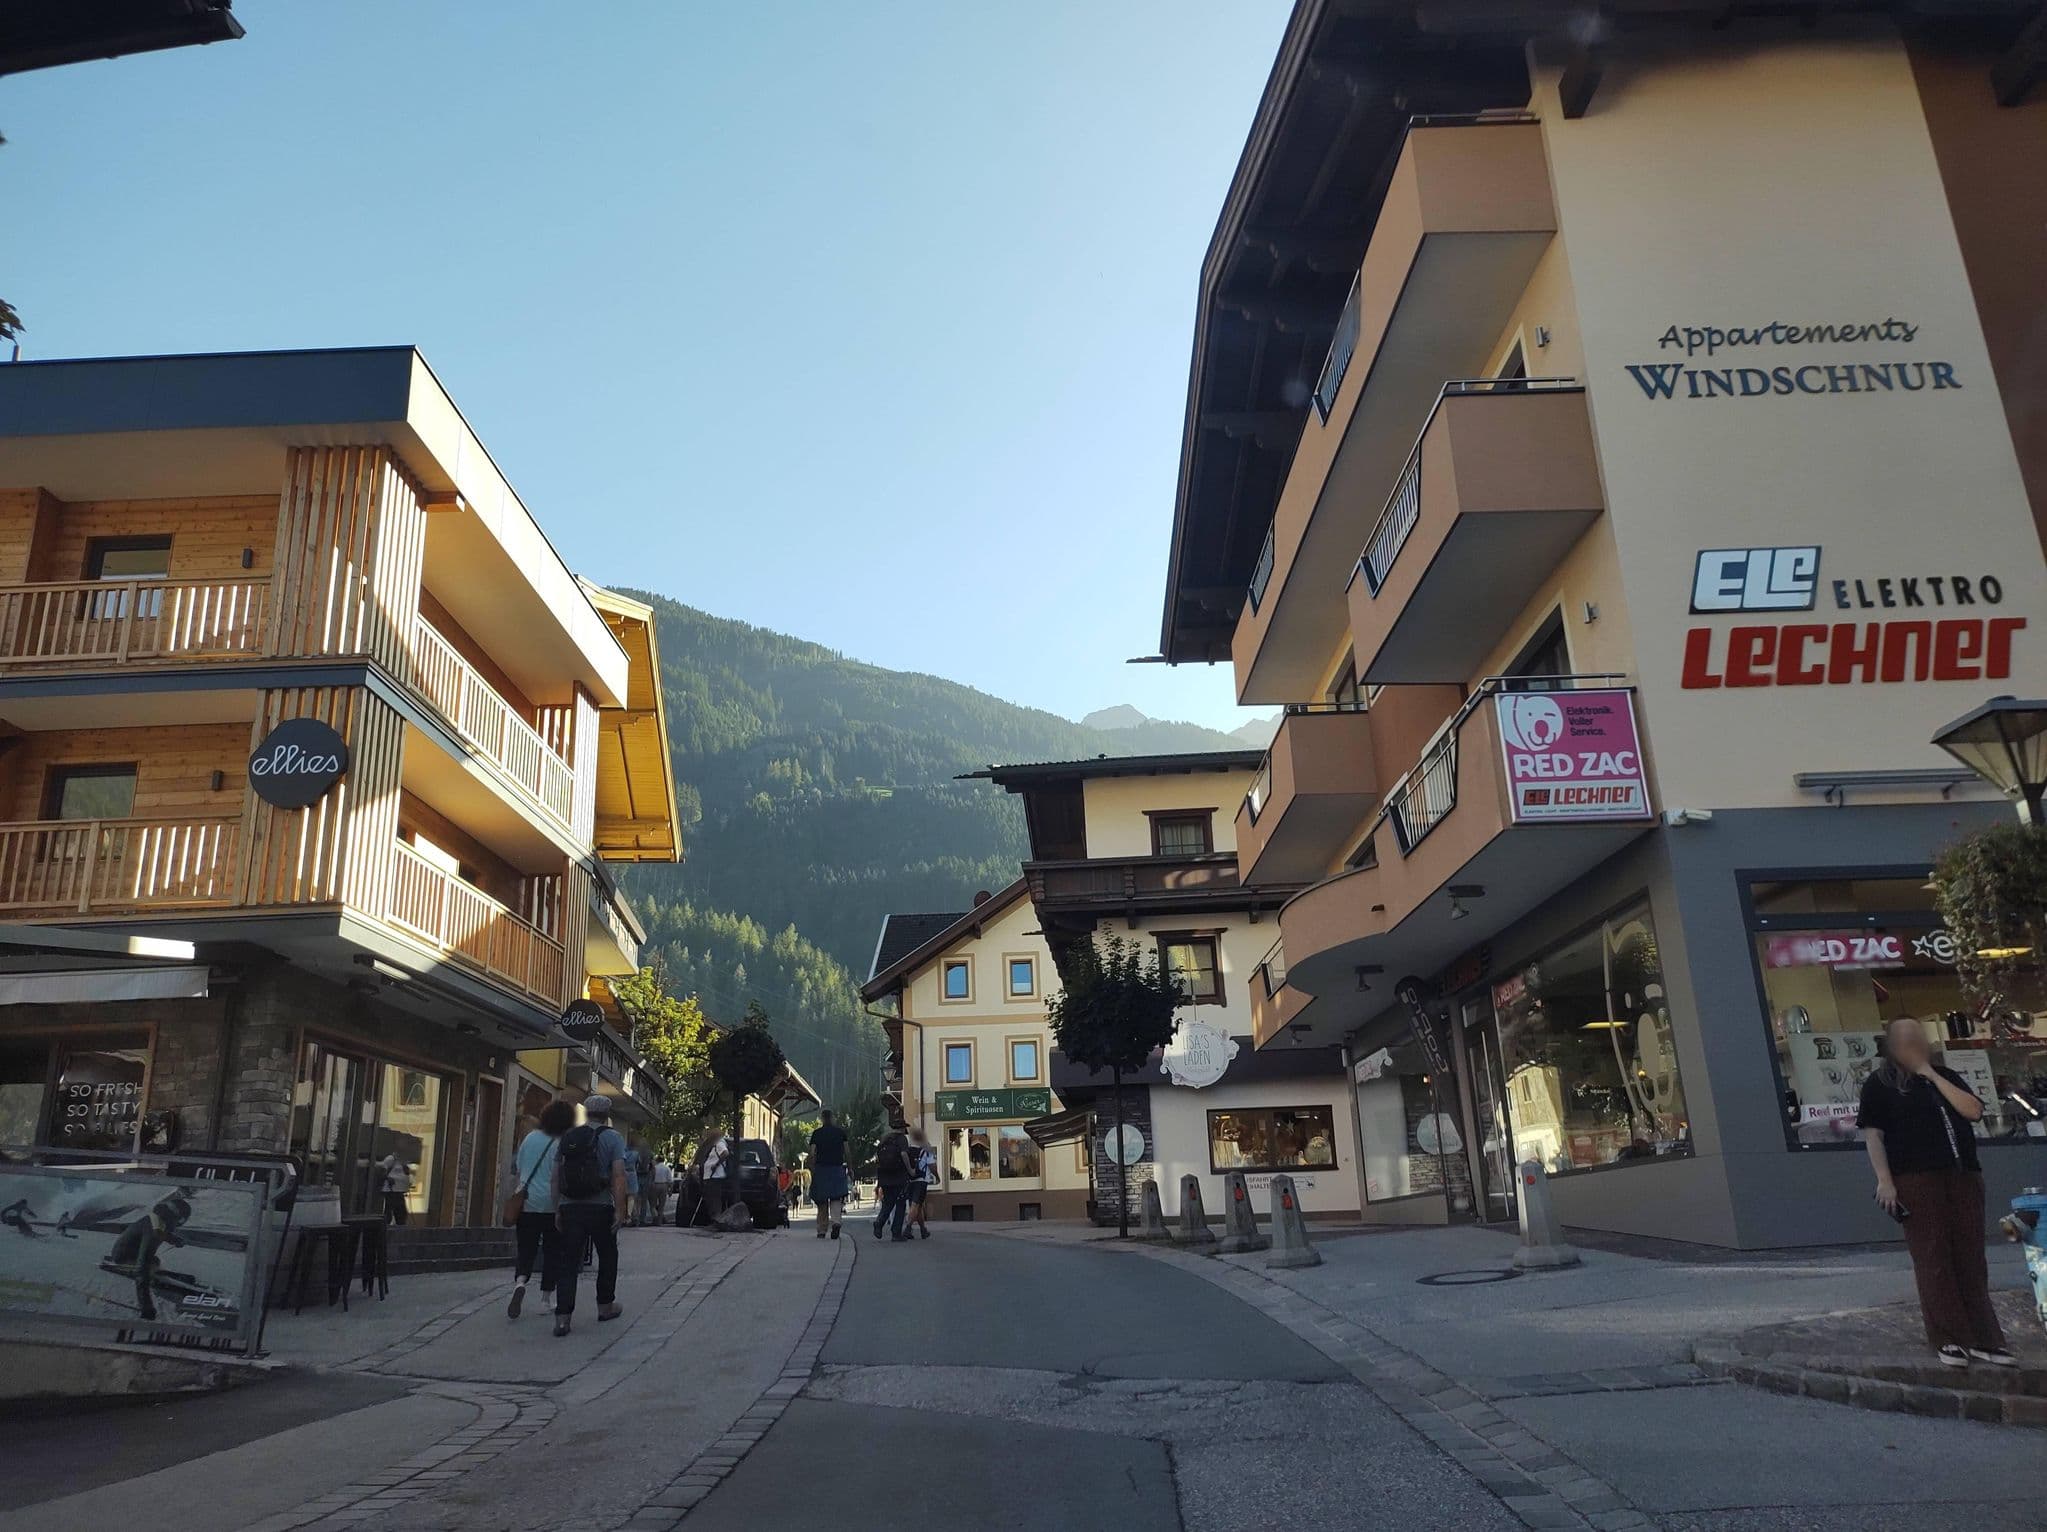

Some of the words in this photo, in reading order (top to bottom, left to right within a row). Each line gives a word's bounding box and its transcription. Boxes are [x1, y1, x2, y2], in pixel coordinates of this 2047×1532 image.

[1658, 317, 1919, 357] Appartements
[1625, 361, 1962, 400] WINDSCHNUR
[1832, 574, 2004, 609] ELEKTRO
[252, 745, 339, 775] ellies
[1512, 753, 1575, 778] RED
[1578, 751, 1638, 776] ZAC
[1849, 936, 1901, 959] ZAC
[562, 1010, 600, 1026] ellies
[70, 1084, 92, 1097] SO
[971, 1096, 989, 1104] Wein
[67, 1103, 89, 1117] SO
[965, 1105, 1004, 1115] Spirituosen
[182, 1293, 232, 1308] elan
